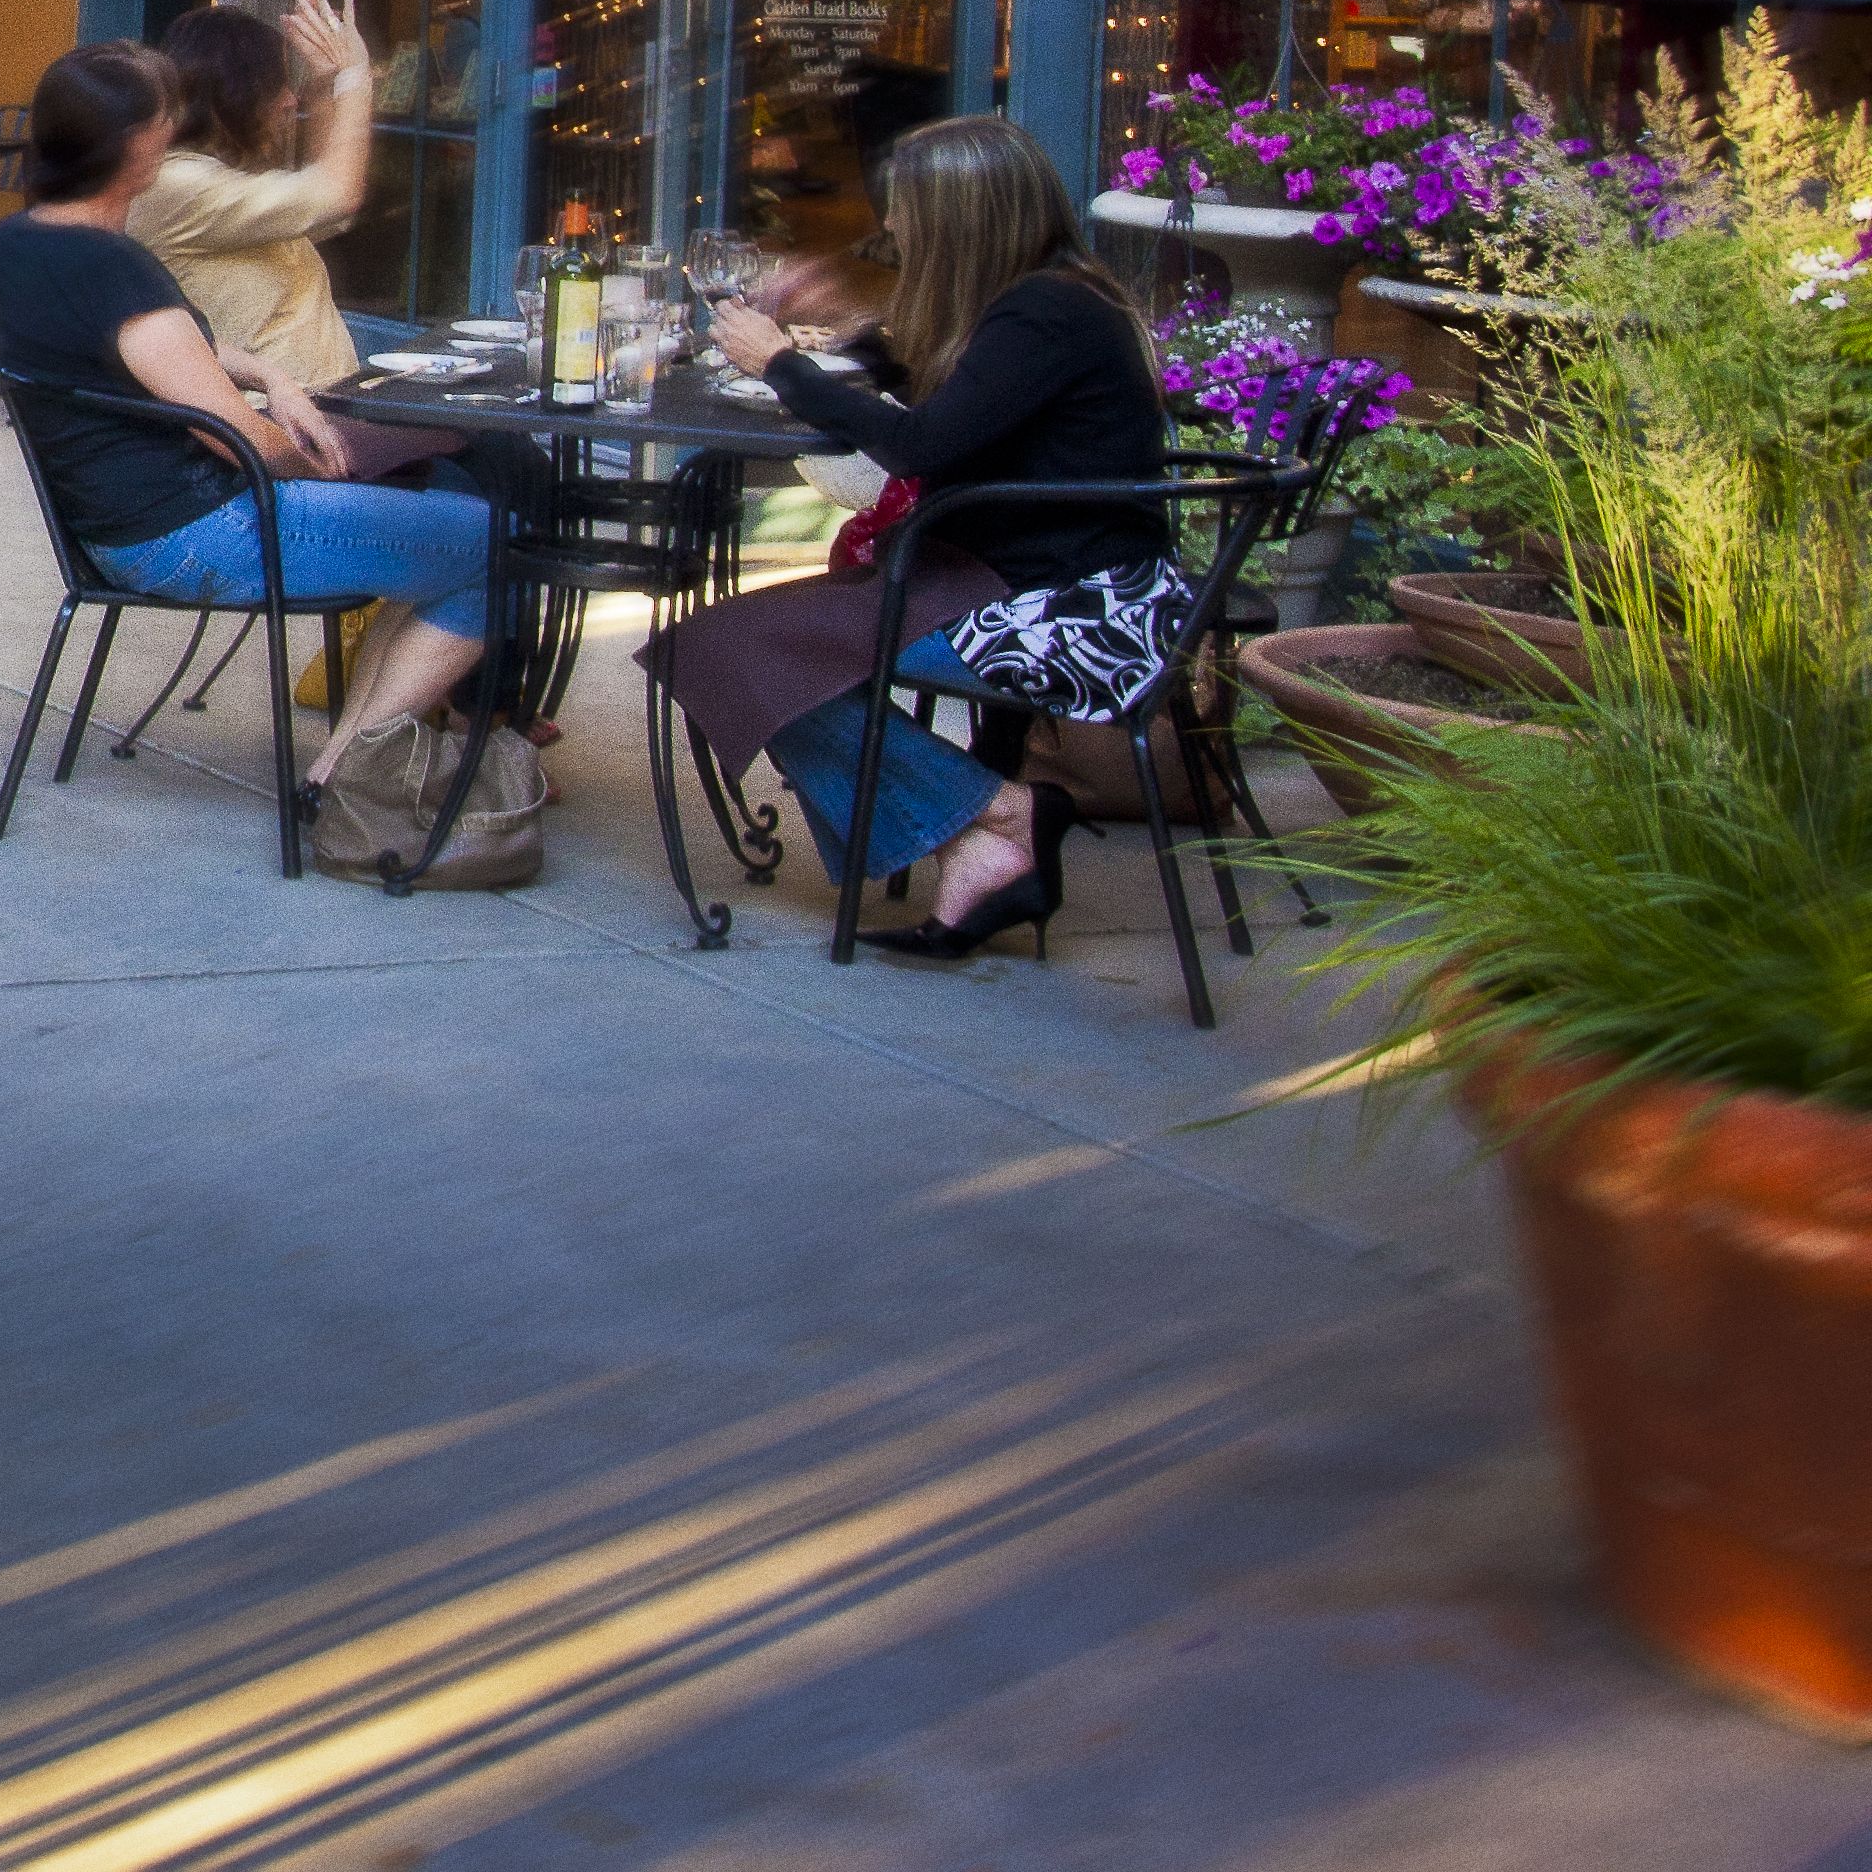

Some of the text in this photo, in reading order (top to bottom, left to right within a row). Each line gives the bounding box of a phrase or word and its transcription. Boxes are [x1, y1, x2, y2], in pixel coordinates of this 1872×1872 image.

[764, 0, 888, 18] Golden Braid Books
[768, 27, 816, 42] Monday
[831, 27, 880, 43] Saturday
[804, 62, 843, 77] Sunday
